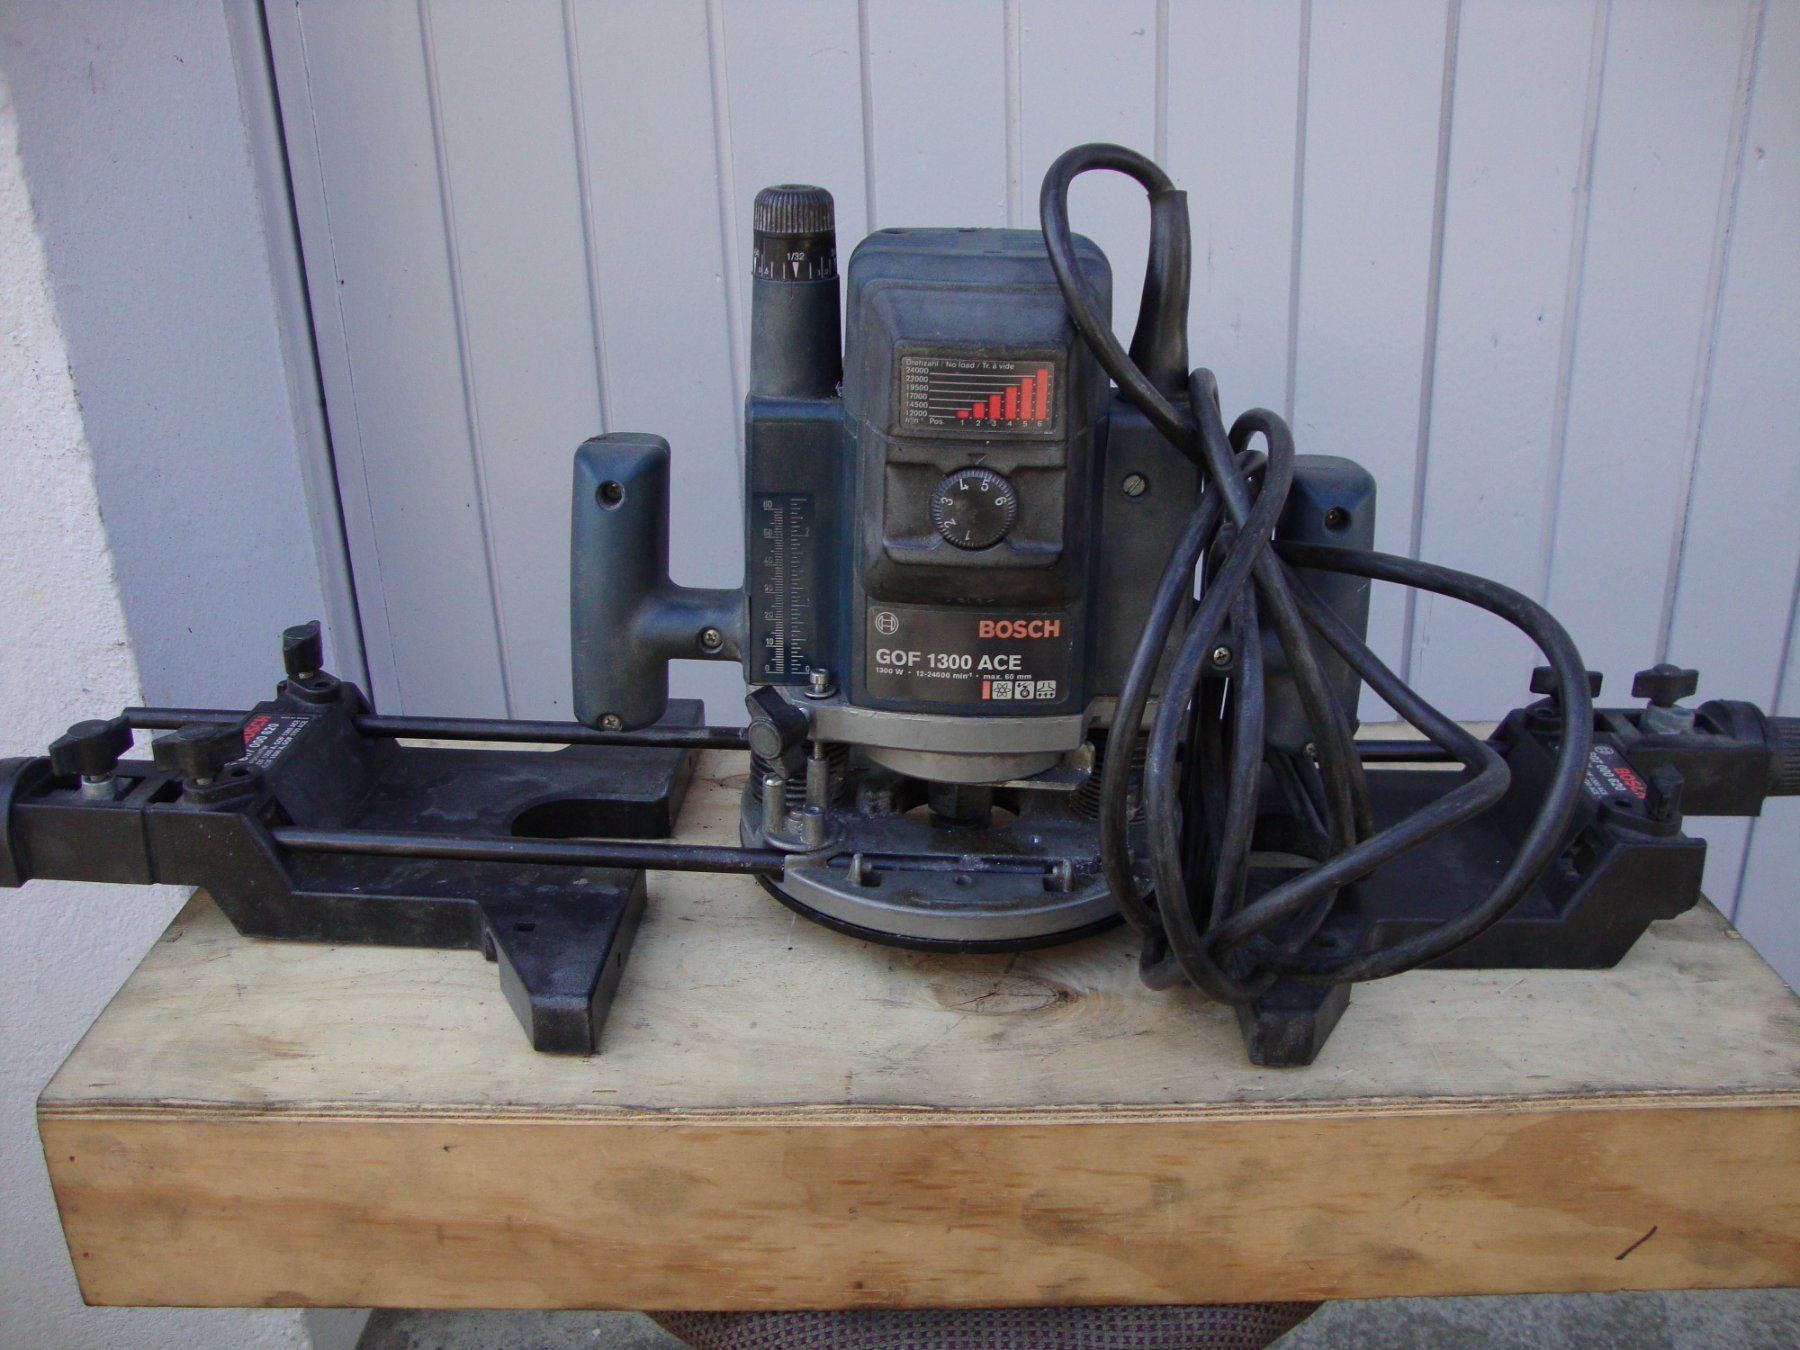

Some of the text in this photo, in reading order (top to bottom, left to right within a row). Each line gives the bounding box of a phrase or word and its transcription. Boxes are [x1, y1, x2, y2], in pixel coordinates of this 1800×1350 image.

[787, 252, 805, 261] 1/32
[906, 359, 939, 367] Drehzahl
[959, 361, 975, 369] load
[906, 401, 929, 409] 14500
[959, 478, 1007, 506] 4 5 6
[940, 497, 953, 506] 3
[944, 518, 957, 528] 2
[979, 619, 1060, 638] BOSCH
[875, 648, 1022, 670] GOF 1300 ACE
[916, 671, 951, 679] 12-24000
[243, 713, 273, 745] OSCH
